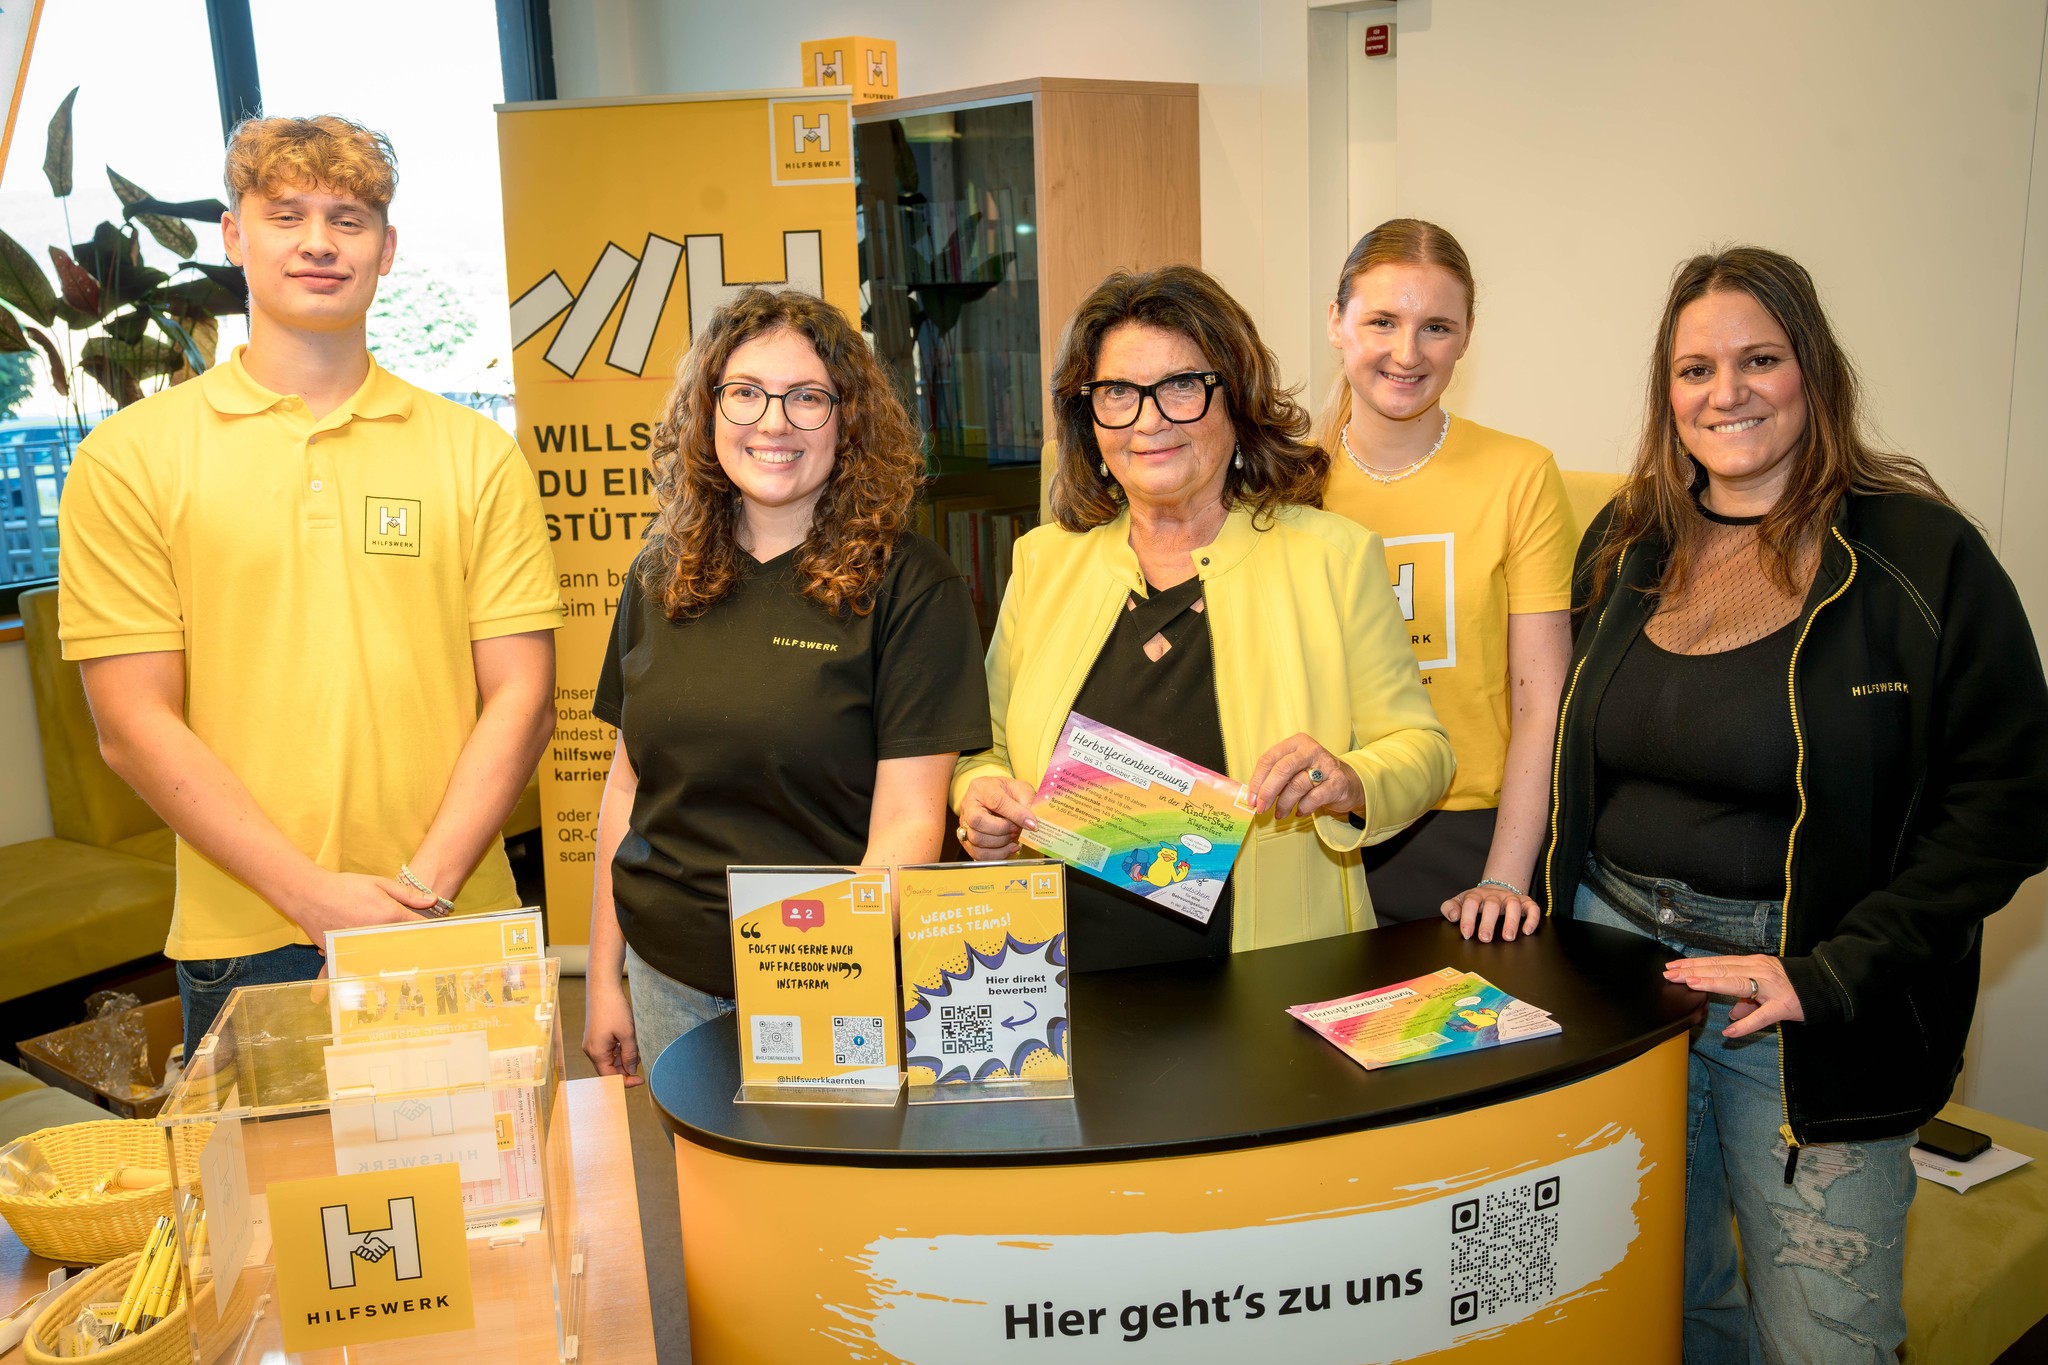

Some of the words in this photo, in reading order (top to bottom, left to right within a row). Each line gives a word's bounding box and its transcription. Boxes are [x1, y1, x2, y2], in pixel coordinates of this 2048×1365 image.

[785, 160, 842, 170] HILFSWERK
[533, 422, 663, 453] WILLS
[538, 469, 587, 498] DU
[603, 467, 656, 496] EIN
[544, 507, 660, 542] STÜTZ
[372, 540, 414, 548] HILFSWERK
[560, 572, 599, 588] ann
[562, 600, 595, 616] eim
[772, 636, 839, 652] HILFSWERK
[1852, 682, 1909, 697] HILFSWERK
[553, 748, 615, 761] hilfswe
[1072, 732, 1189, 792] Herbstferienbetreuung
[555, 768, 609, 781] karrier
[1072, 750, 1081, 758] 27.
[1083, 755, 1093, 763] bis
[1094, 759, 1104, 767] 31.
[1105, 764, 1130, 779] Oktober
[1131, 775, 1147, 786] 2025
[1158, 793, 1167, 801] in
[1167, 796, 1180, 807] der
[557, 809, 591, 822] oder
[1180, 801, 1234, 832] KinderStadt
[1186, 816, 1222, 839] Klagenfurt
[558, 828, 597, 843] QR-C
[560, 851, 596, 862] scan
[1180, 882, 1211, 900] Gutschein
[805, 909, 813, 919] 2
[921, 908, 963, 924] WERDE
[966, 904, 993, 916] TEIL
[907, 923, 963, 941] UNSERES
[966, 912, 1011, 931] TEAMS!
[749, 944, 776, 954] FOLGT
[779, 944, 795, 955] UNS
[798, 944, 828, 955] GERNE
[831, 945, 853, 955] AUCH
[759, 961, 775, 971] AUF
[777, 961, 824, 972] FACEBOOK
[777, 978, 829, 989] INSTAGRAM
[986, 976, 1009, 984] Hier
[1012, 975, 1046, 983] direkt
[988, 985, 1047, 995] bewerben!
[777, 1075, 865, 1085] @hilfswerkkaernten
[307, 1295, 450, 1325] HILFSWERK
[1005, 1301, 1106, 1340] Hier
[1278, 1284, 1331, 1317] zu
[1346, 1268, 1423, 1306] uns
